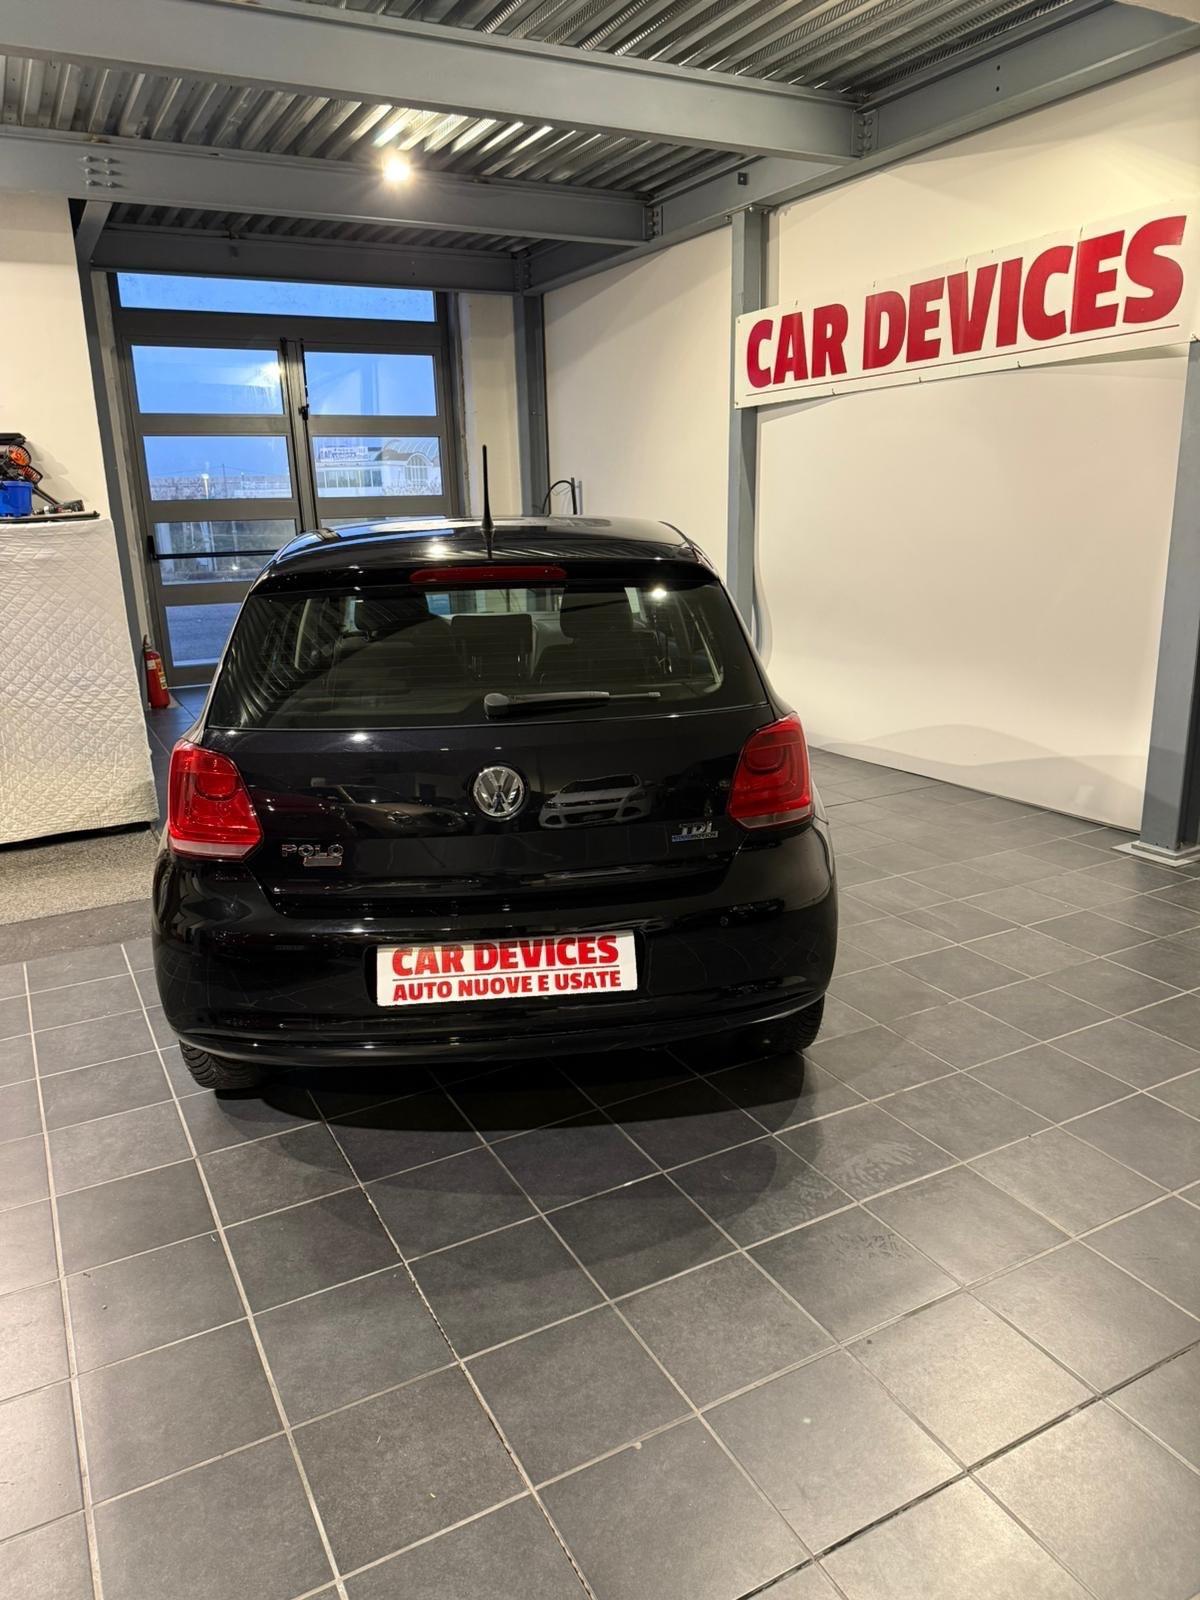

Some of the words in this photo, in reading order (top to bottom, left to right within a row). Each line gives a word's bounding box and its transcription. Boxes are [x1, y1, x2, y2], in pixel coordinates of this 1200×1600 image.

[746, 303, 848, 388] CAR
[862, 215, 1187, 370] DEVICES
[679, 821, 713, 835] TDI
[281, 843, 344, 857] POLO
[392, 944, 464, 976] CAR
[473, 935, 619, 971] DEVICES
[393, 980, 452, 1002] AUTO
[458, 975, 532, 997] NUOVE
[538, 974, 549, 992] E
[554, 970, 621, 991] USATE
